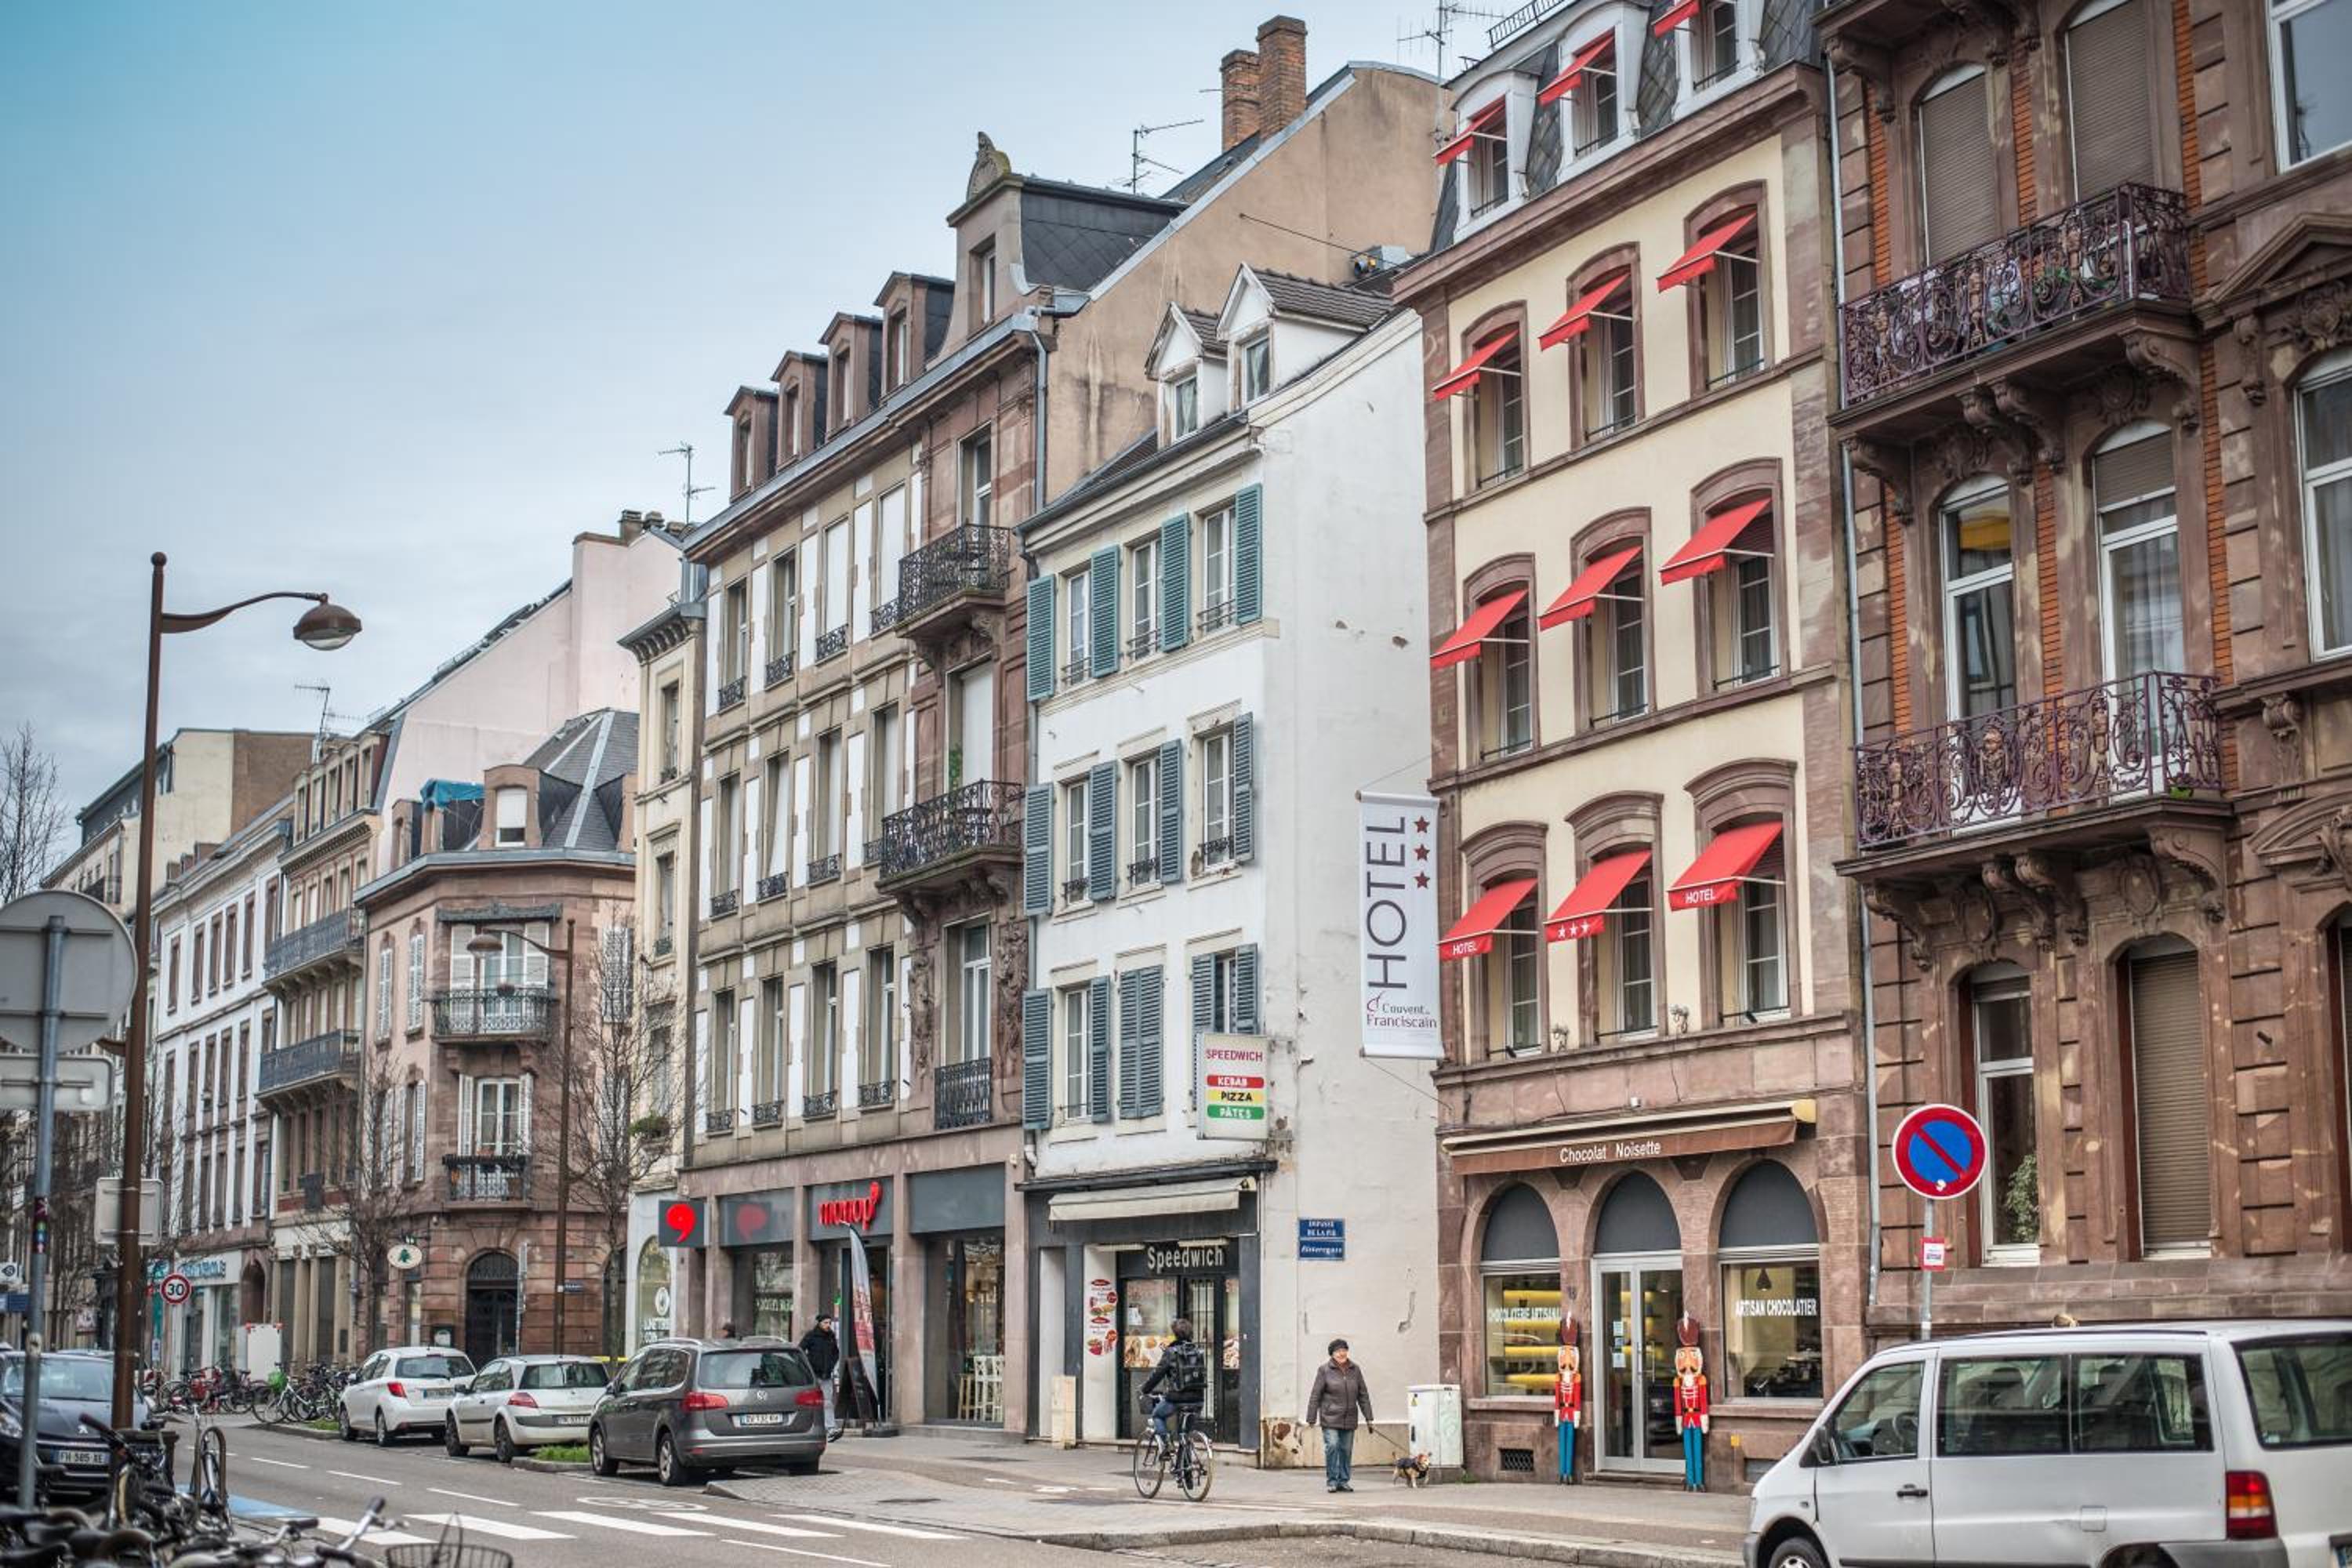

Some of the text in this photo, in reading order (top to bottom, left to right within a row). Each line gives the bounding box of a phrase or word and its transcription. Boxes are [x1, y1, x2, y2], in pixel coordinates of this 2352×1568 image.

[1366, 816, 1406, 989] HOTEL
[1685, 888, 1716, 904] HOTEL
[1452, 942, 1478, 956] HOTEL
[1382, 1003, 1424, 1014] Couvent
[1367, 1014, 1437, 1028] Franciscain
[1206, 1050, 1263, 1062] SPEEDWICH
[1218, 1076, 1248, 1087] KEBAB
[1220, 1091, 1253, 1102] PIZZA
[1219, 1106, 1252, 1119] PÂTES
[1559, 1140, 1661, 1163] Chocolat Noisette
[1147, 1245, 1224, 1274] Speedwich
[167, 1283, 185, 1295] 30
[1735, 1298, 1817, 1316] ARTISAN CHOCOLATIER
